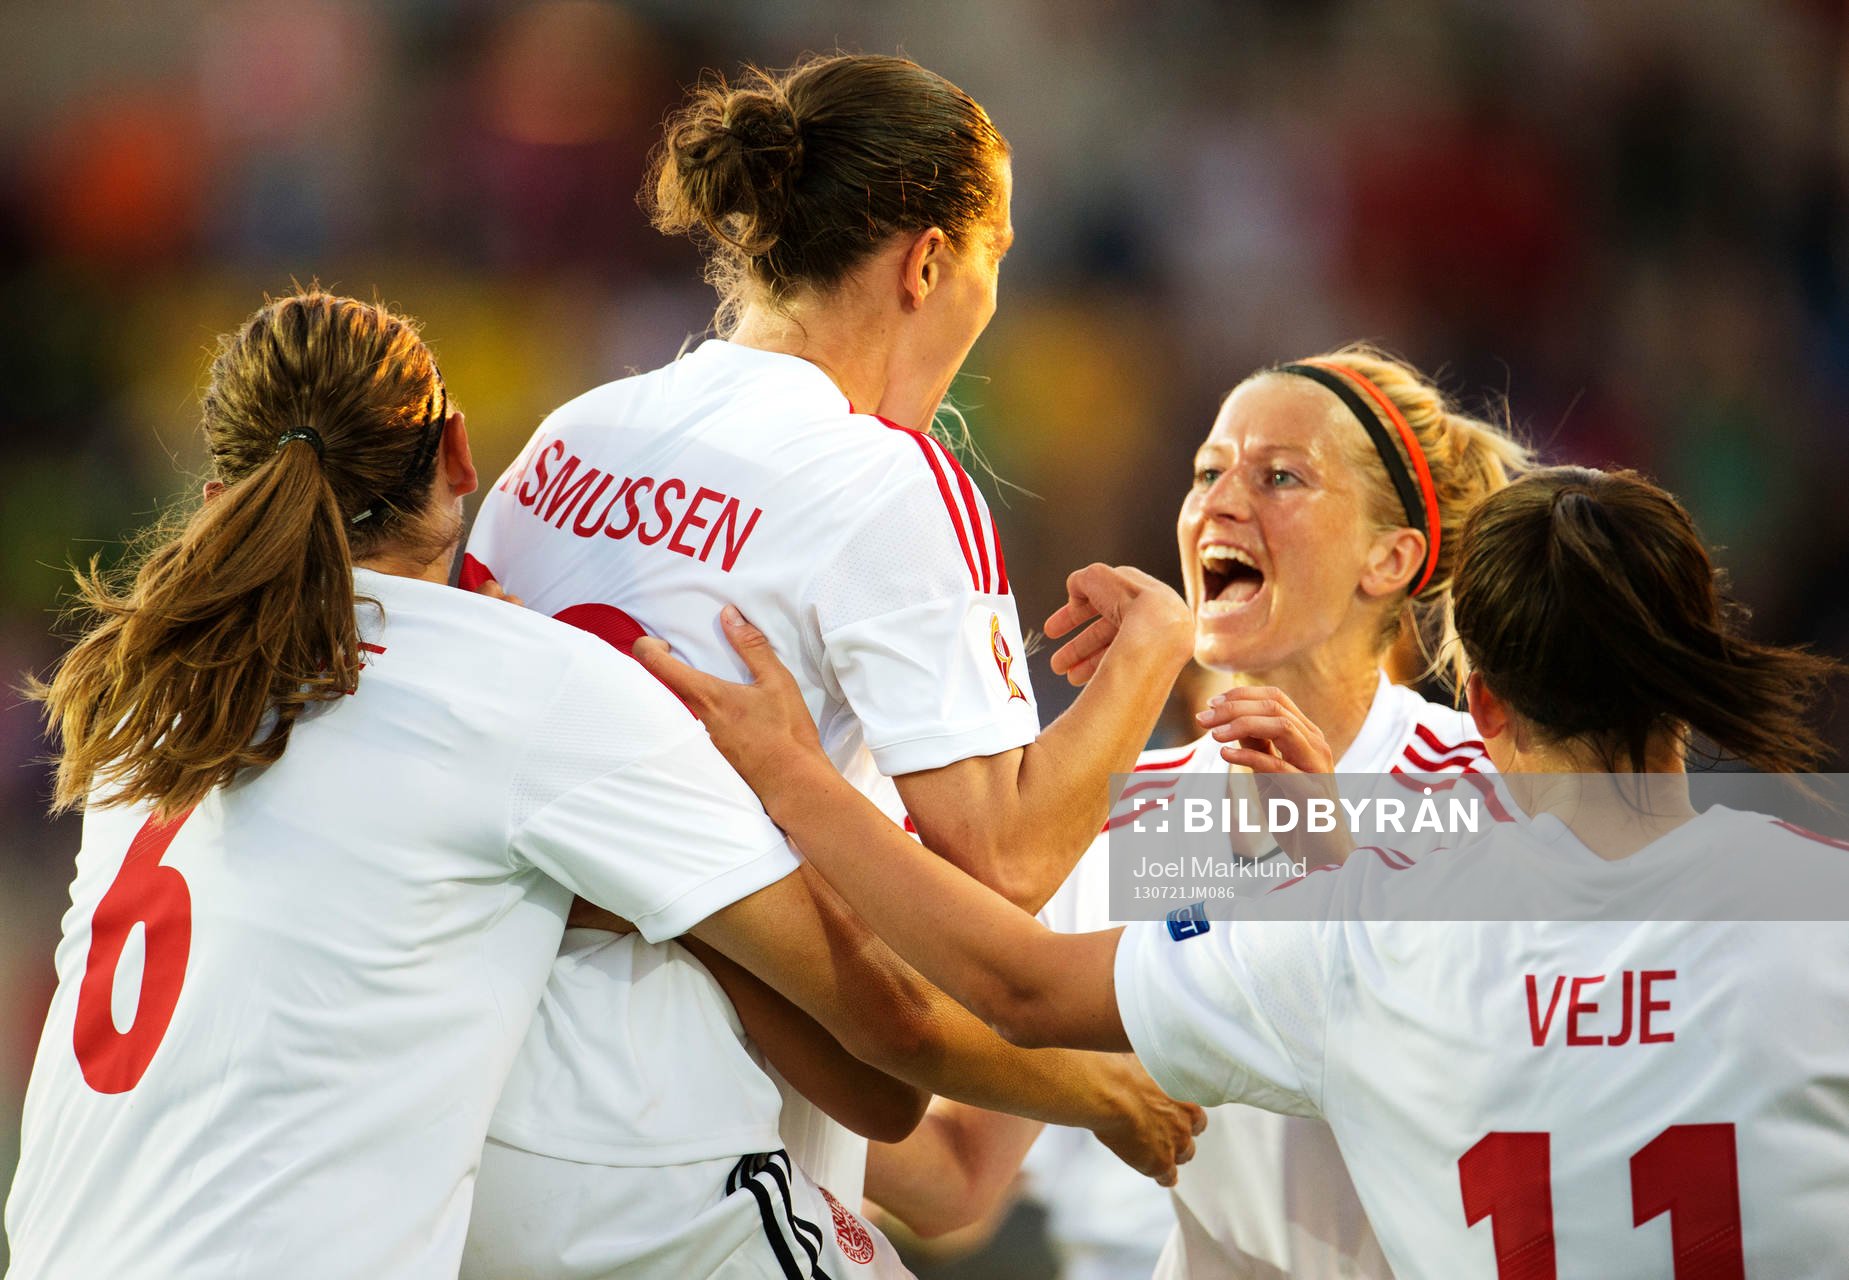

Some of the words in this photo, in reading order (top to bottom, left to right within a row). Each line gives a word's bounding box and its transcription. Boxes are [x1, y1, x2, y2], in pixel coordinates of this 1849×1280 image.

[73, 798, 202, 1095] 6
[1525, 970, 1677, 1047] VEJE
[1457, 1122, 1746, 1280] 11
